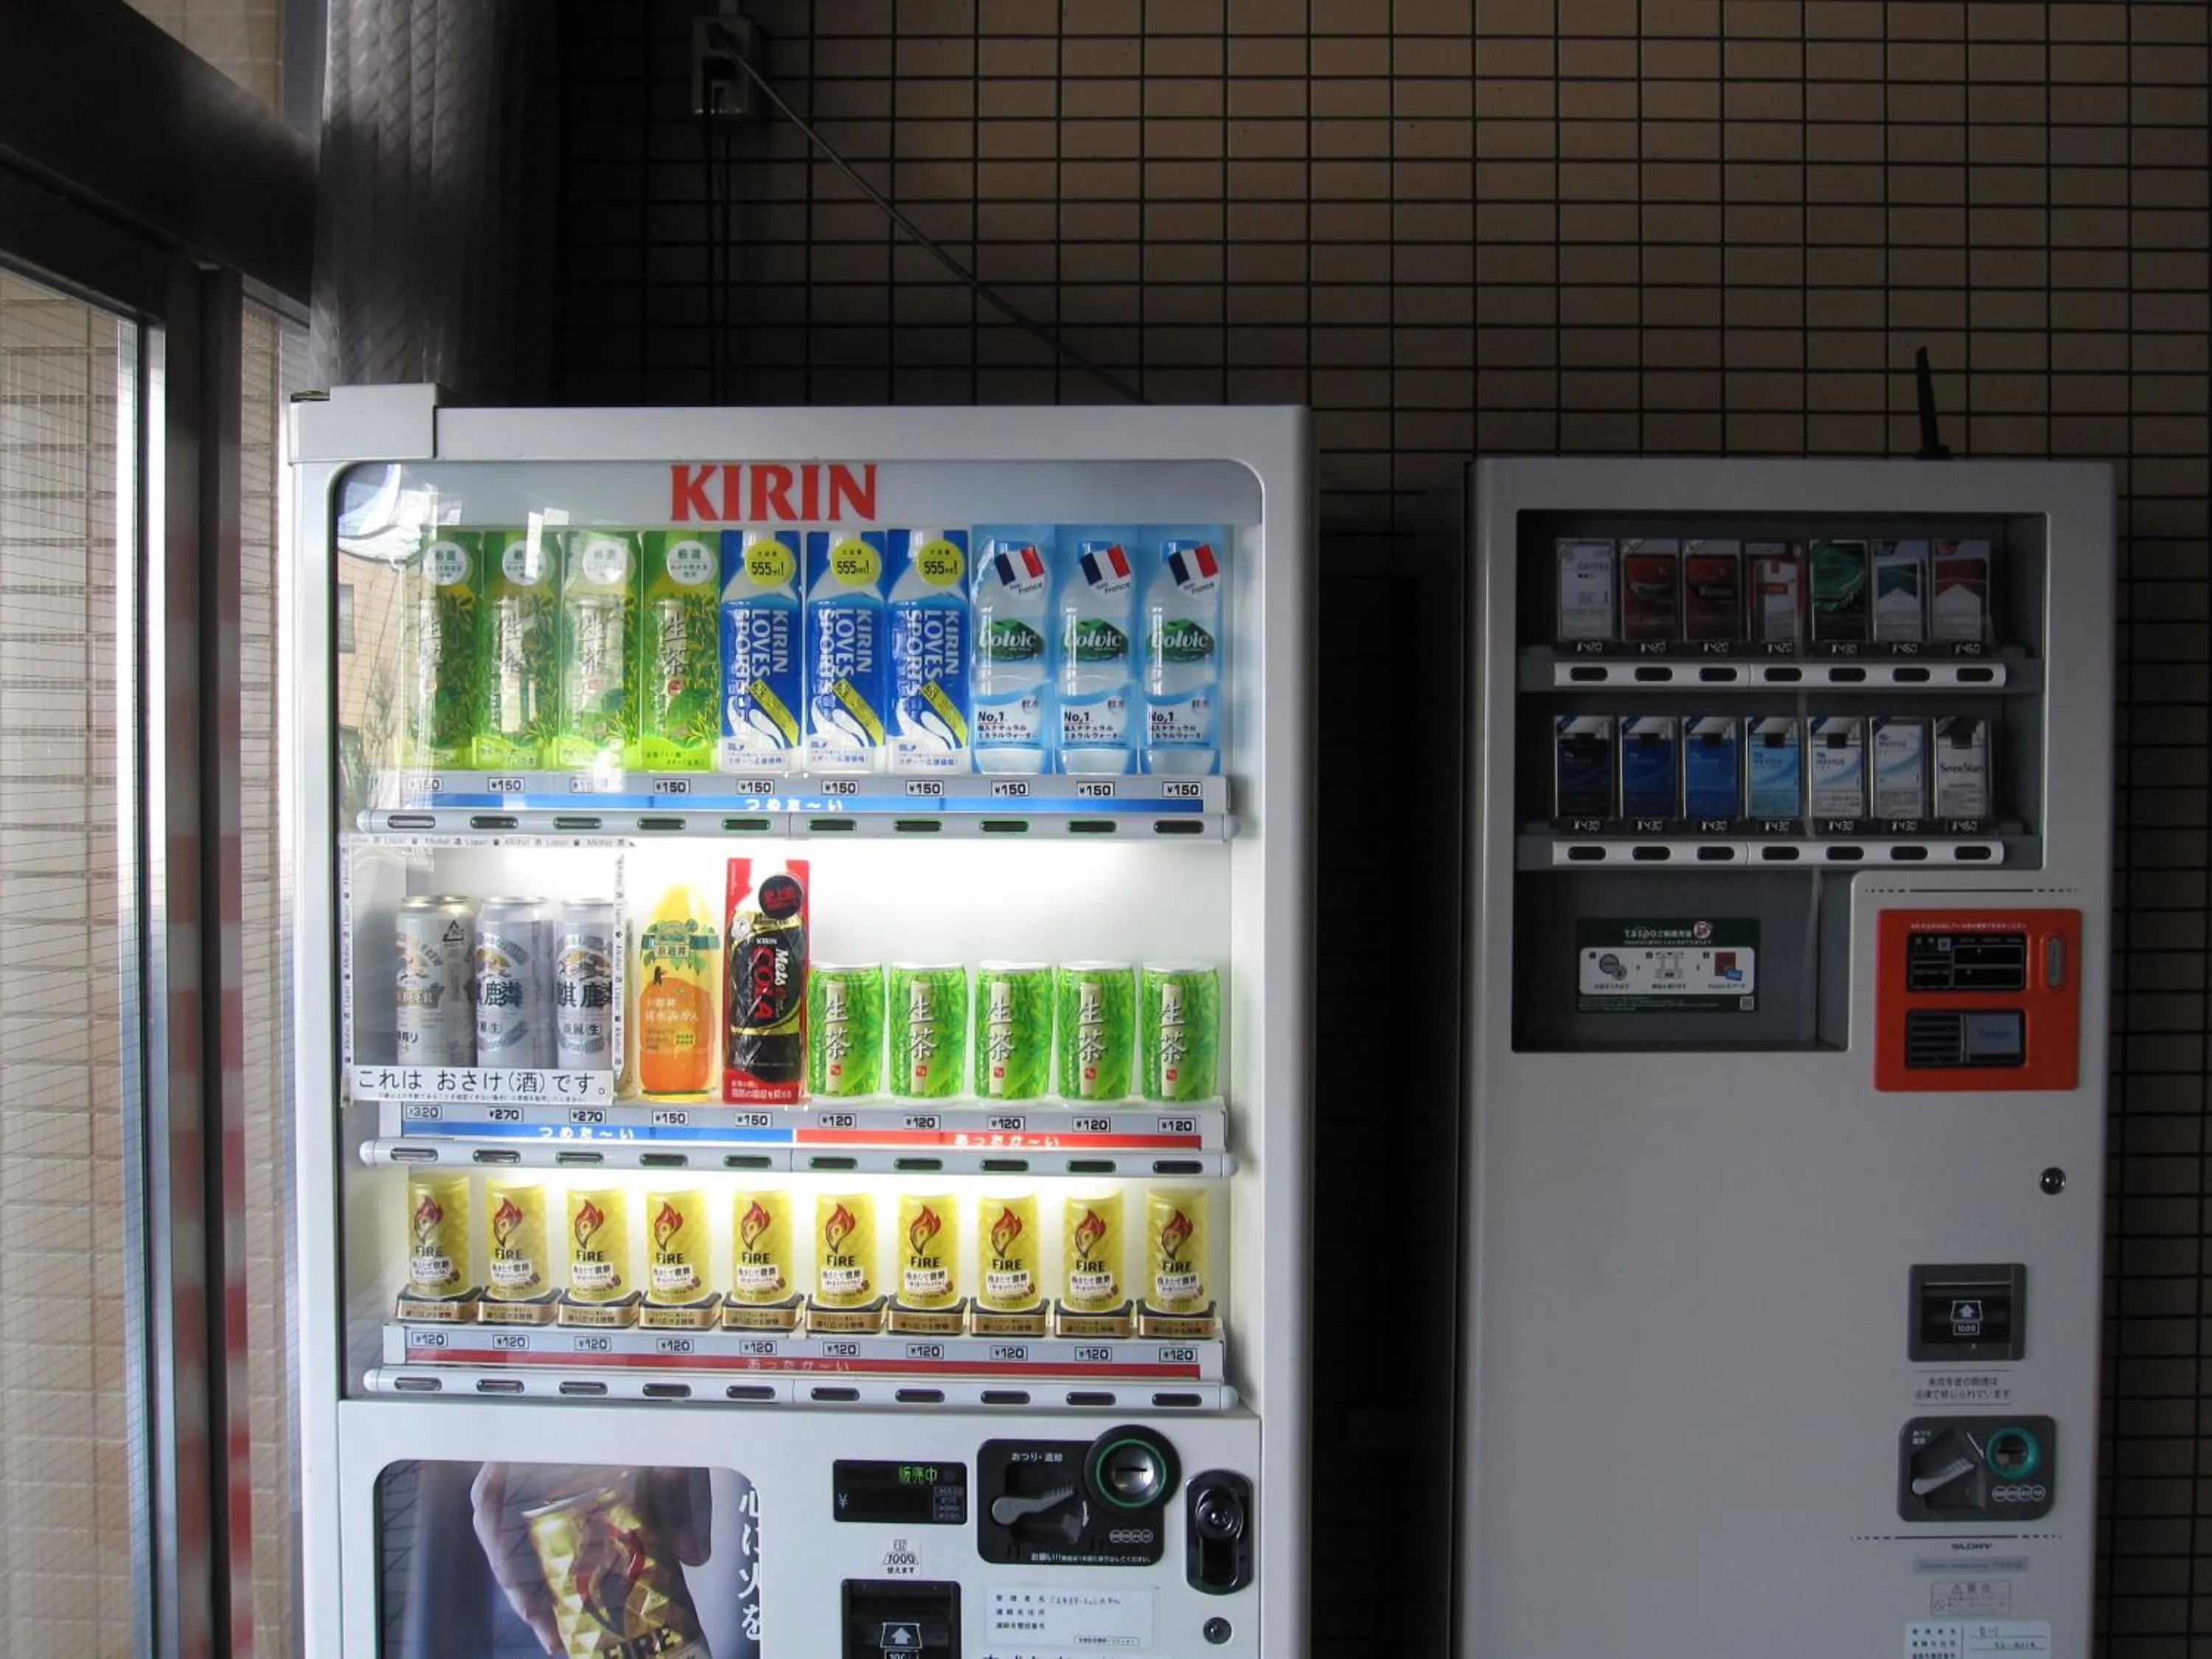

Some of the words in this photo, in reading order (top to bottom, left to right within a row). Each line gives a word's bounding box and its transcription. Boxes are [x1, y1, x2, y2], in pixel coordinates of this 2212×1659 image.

[670, 464, 877, 522] KIRIN
[661, 612, 689, 676] 生茶
[752, 609, 771, 678] LOVES
[772, 609, 789, 673] KIRIN
[835, 609, 855, 678] LOVES
[856, 609, 872, 673] KIRIN
[924, 610, 943, 679] LOVES
[945, 609, 959, 675] KIRIN
[734, 609, 751, 696] SPORTS
[818, 609, 835, 697] SPORTS
[905, 610, 922, 697] SPORTS
[491, 780, 521, 790] ¥150
[655, 782, 687, 793] ¥150
[740, 782, 772, 793] ¥150
[824, 783, 857, 793] ¥150
[908, 784, 941, 794] ¥150
[995, 784, 1026, 795] ¥150
[1079, 785, 1111, 796] ¥150
[1166, 785, 1199, 796] ¥150
[776, 948, 788, 986] Mets
[754, 946, 773, 1018] COLA
[824, 994, 854, 1060] 生茶
[907, 995, 939, 1060] 生茶
[987, 995, 1015, 1062] 生茶
[1077, 996, 1107, 1063] 生茶
[1158, 997, 1187, 1063] 生茶
[360, 1069, 422, 1091] これは
[409, 1107, 439, 1118] ¥320
[490, 1110, 520, 1121] ¥270
[572, 1110, 603, 1122] ¥270
[655, 1113, 686, 1124] ¥150
[737, 1115, 768, 1126] ¥150
[822, 1115, 853, 1126] ¥120
[906, 1117, 936, 1129] ¥120
[992, 1118, 1020, 1129] ¥120
[1076, 1119, 1107, 1130] ¥120
[1161, 1119, 1192, 1131] ¥120
[415, 1245, 442, 1257] FIRE
[494, 1248, 522, 1260] FIRE
[576, 1251, 603, 1262] FIRE
[656, 1252, 684, 1264] FIRE
[742, 1253, 771, 1265] FIRE
[827, 1254, 855, 1266] FIRE
[911, 1256, 940, 1267] FIRE
[992, 1259, 1022, 1270] FIRE
[1076, 1260, 1105, 1272] FIRE
[1162, 1261, 1192, 1272] FIRE
[416, 1335, 444, 1345] ¥120
[496, 1337, 526, 1347] ¥120
[578, 1338, 608, 1349] ¥120
[661, 1341, 690, 1352] ¥120
[744, 1342, 773, 1353] ¥120
[827, 1344, 857, 1354] ¥120
[911, 1346, 940, 1357] ¥120
[995, 1347, 1024, 1357] ¥120
[1079, 1349, 1108, 1360] ¥120
[1164, 1349, 1193, 1360] ¥120
[899, 1465, 938, 1485] 販売中
[838, 1492, 849, 1509] ¥
